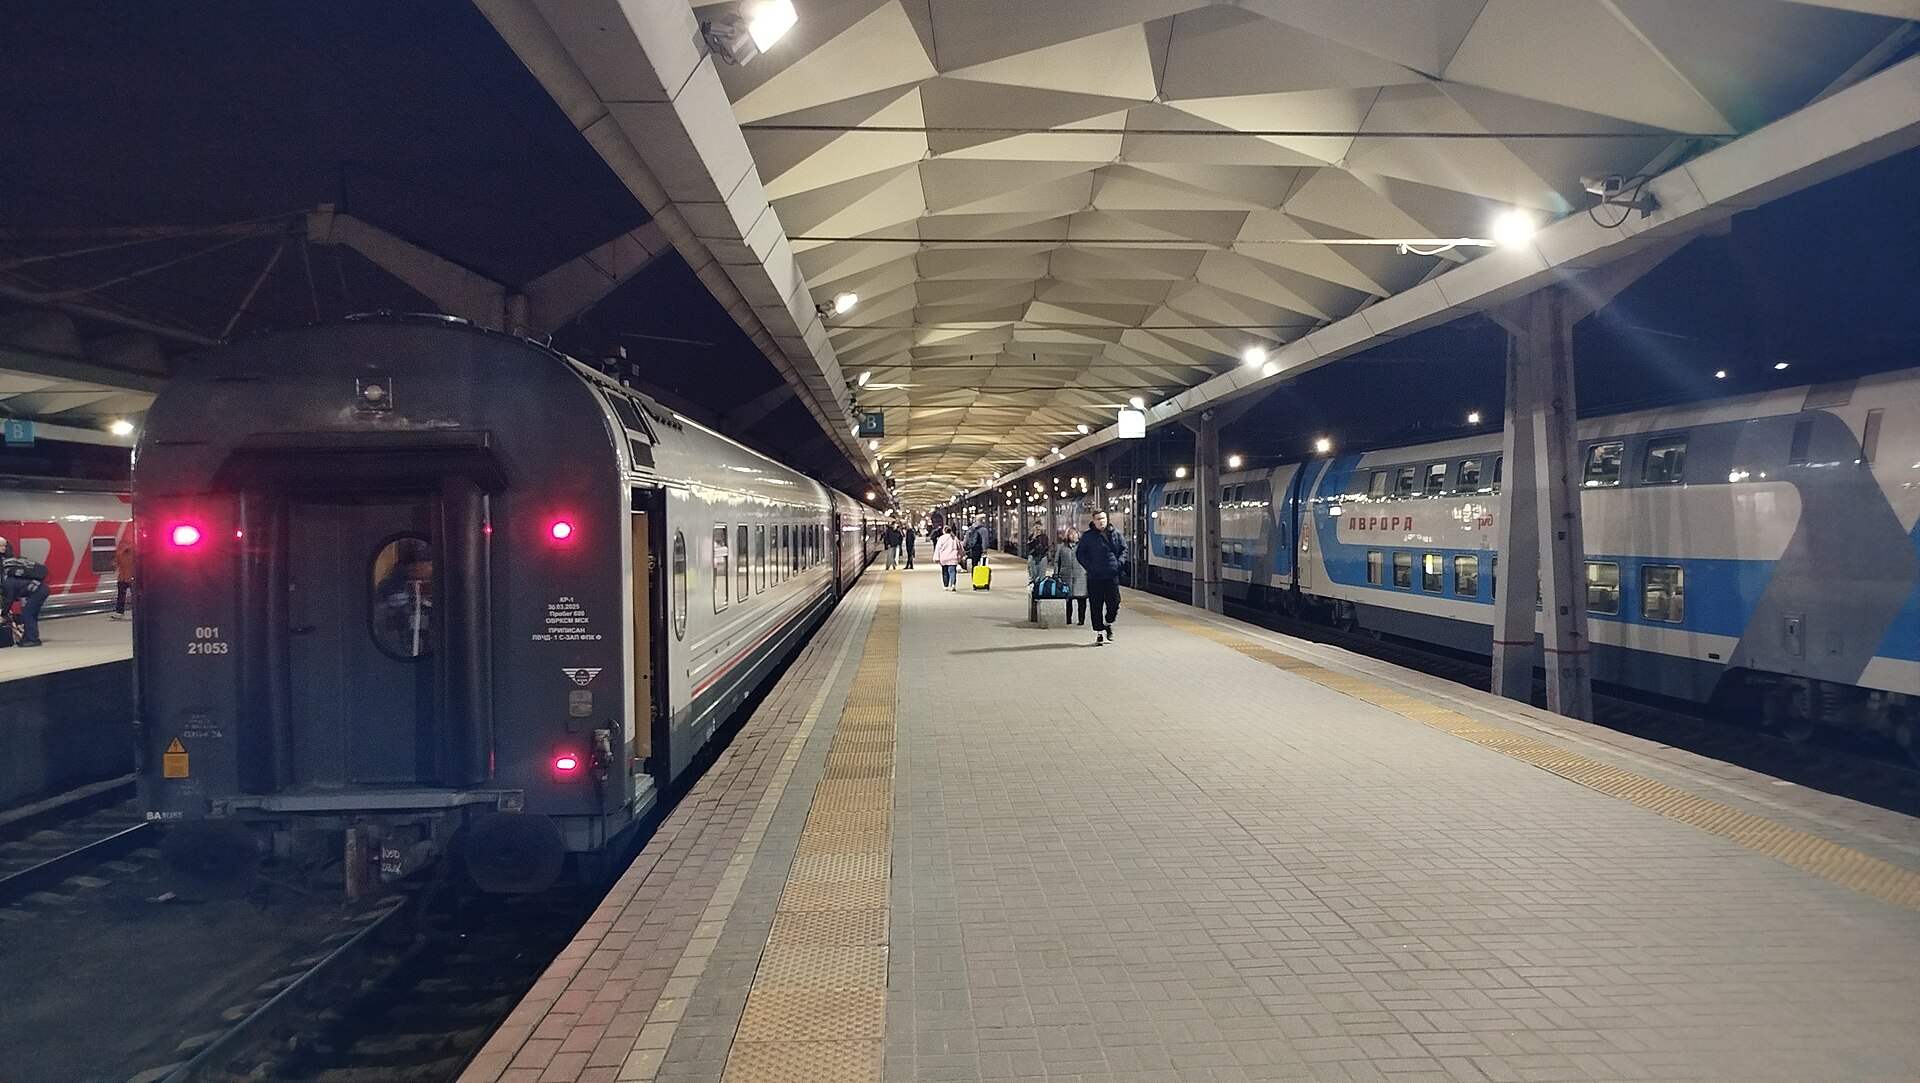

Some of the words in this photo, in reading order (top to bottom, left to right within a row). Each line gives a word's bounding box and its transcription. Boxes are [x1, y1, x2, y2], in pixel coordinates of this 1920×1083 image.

[1349, 516, 1413, 531] АВРОРА
[549, 610, 573, 618] Пробег
[195, 626, 219, 639] 001
[187, 642, 229, 655] 21053
